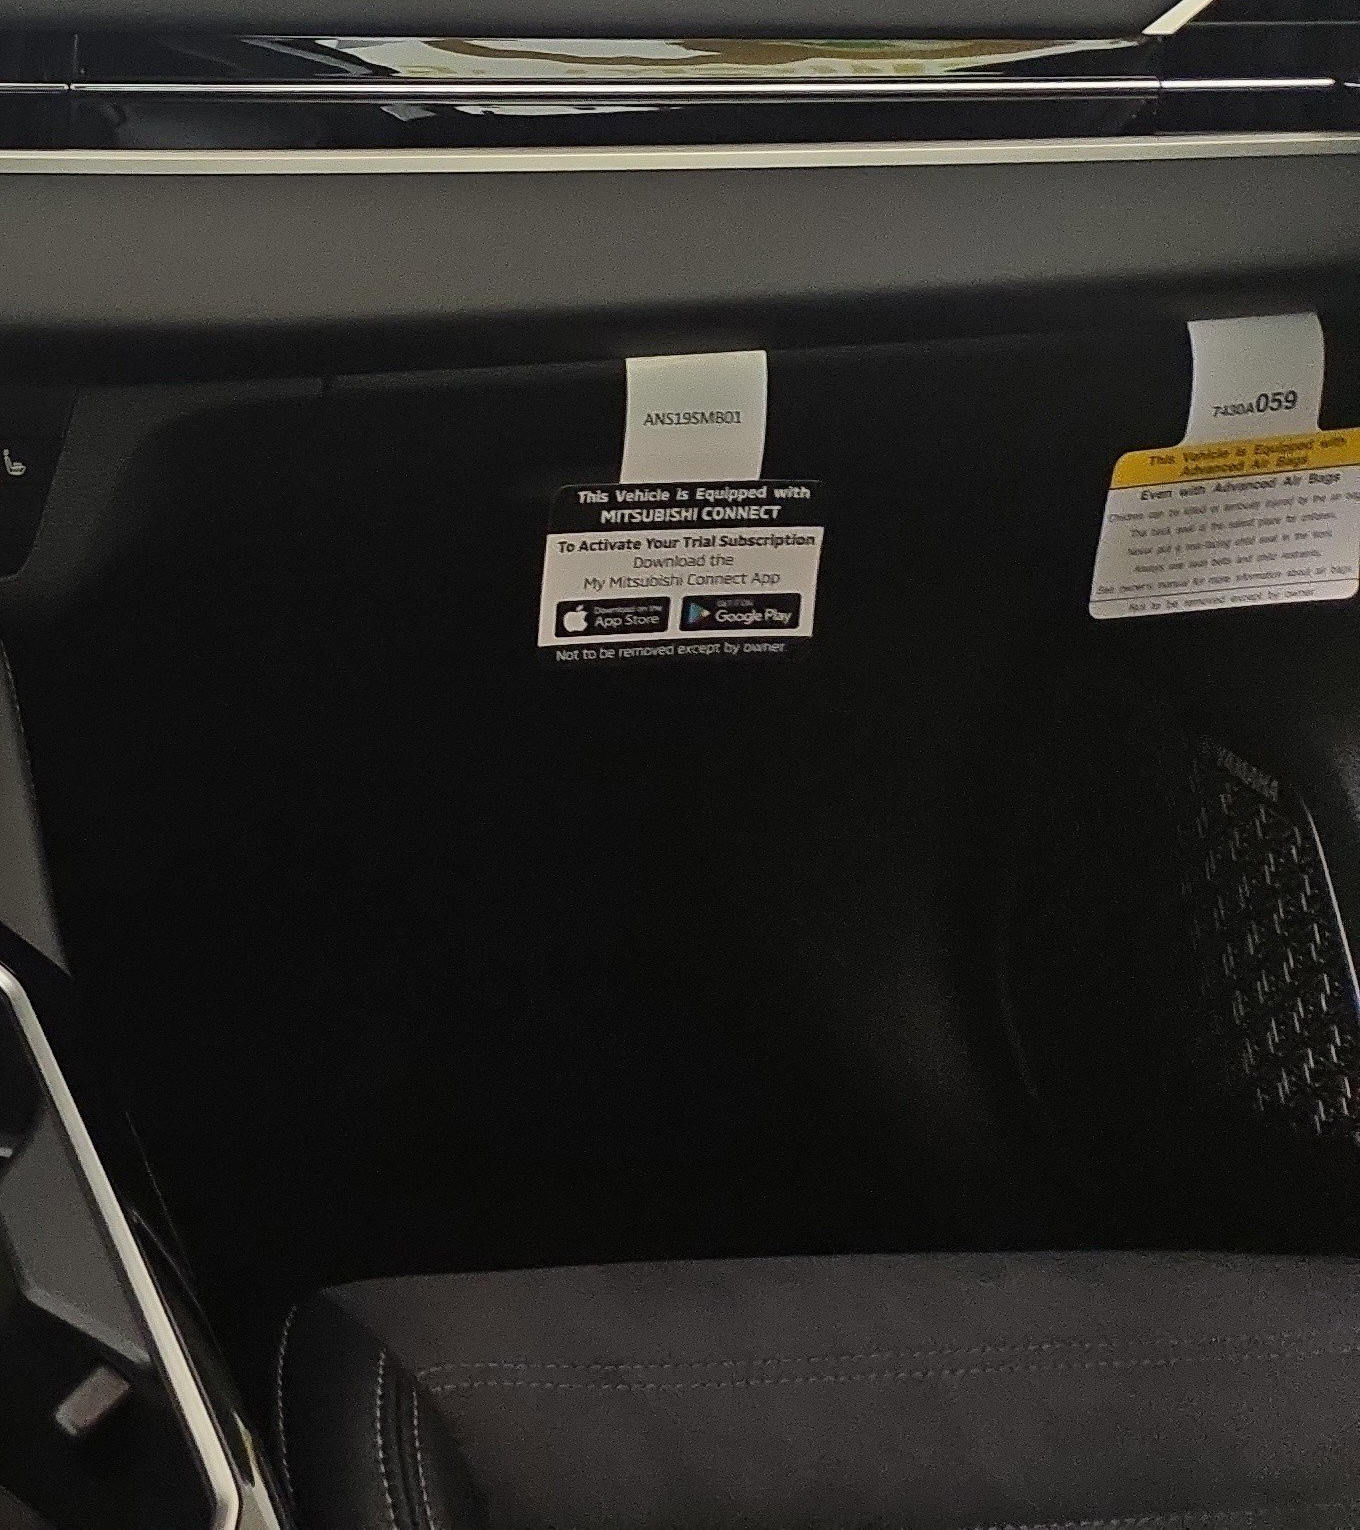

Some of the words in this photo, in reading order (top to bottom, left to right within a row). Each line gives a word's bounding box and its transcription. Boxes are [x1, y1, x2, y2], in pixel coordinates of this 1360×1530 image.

[578, 491, 609, 504] This
[615, 488, 670, 502] Vehicle
[676, 488, 689, 501] is
[695, 486, 767, 502] Equipped
[773, 486, 811, 500] with
[1140, 490, 1173, 501] Even
[1179, 486, 1206, 498] with
[1213, 479, 1277, 493] Advanced
[1283, 475, 1302, 487] Air
[1308, 472, 1341, 486] Bags
[600, 507, 698, 524] MITSUBISHI
[701, 505, 782, 521] CONNECT
[557, 540, 575, 553] To
[580, 538, 642, 552] Activate
[646, 537, 680, 550] Your
[683, 536, 717, 548] Trial
[720, 534, 816, 549] Subscription
[633, 555, 706, 569] Download
[709, 554, 735, 566] the
[583, 577, 603, 592] My
[609, 574, 684, 589] Mitsubishi
[687, 573, 747, 587] Connect
[750, 572, 781, 587] App
[594, 616, 623, 629] App
[624, 613, 660, 626] Store
[715, 609, 763, 626] Google
[764, 609, 793, 624] Play
[556, 650, 580, 662] Not
[582, 649, 597, 660] to
[599, 647, 616, 659] be
[618, 645, 675, 658] removed
[677, 644, 721, 657] except
[724, 642, 740, 655] by
[742, 642, 786, 654] owner
